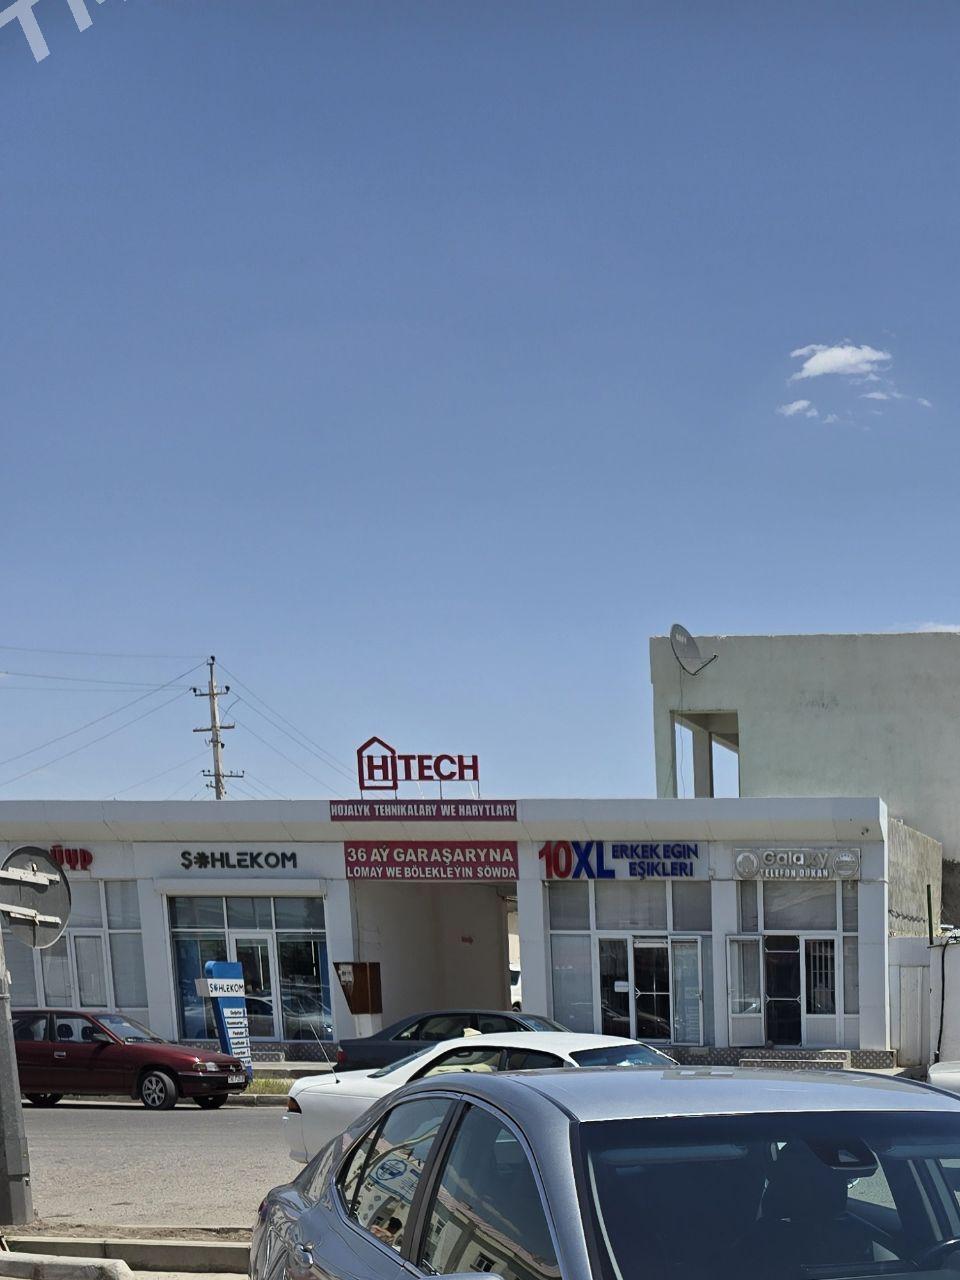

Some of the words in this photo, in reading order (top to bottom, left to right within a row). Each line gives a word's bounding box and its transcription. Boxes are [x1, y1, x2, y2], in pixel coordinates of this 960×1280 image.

[331, 804, 370, 816] HOJALYK
[374, 804, 437, 816] TEHNIKALARY
[441, 804, 456, 816] WE
[458, 804, 515, 816] HARYTLARY
[347, 848, 366, 862] 36
[370, 845, 390, 862] AÝ
[394, 848, 513, 865] GARAŞARYNA
[611, 844, 660, 859] ERKEK
[347, 865, 382, 877] LOMAÝ
[386, 867, 402, 877] WE
[477, 865, 516, 877] SÖWDA
